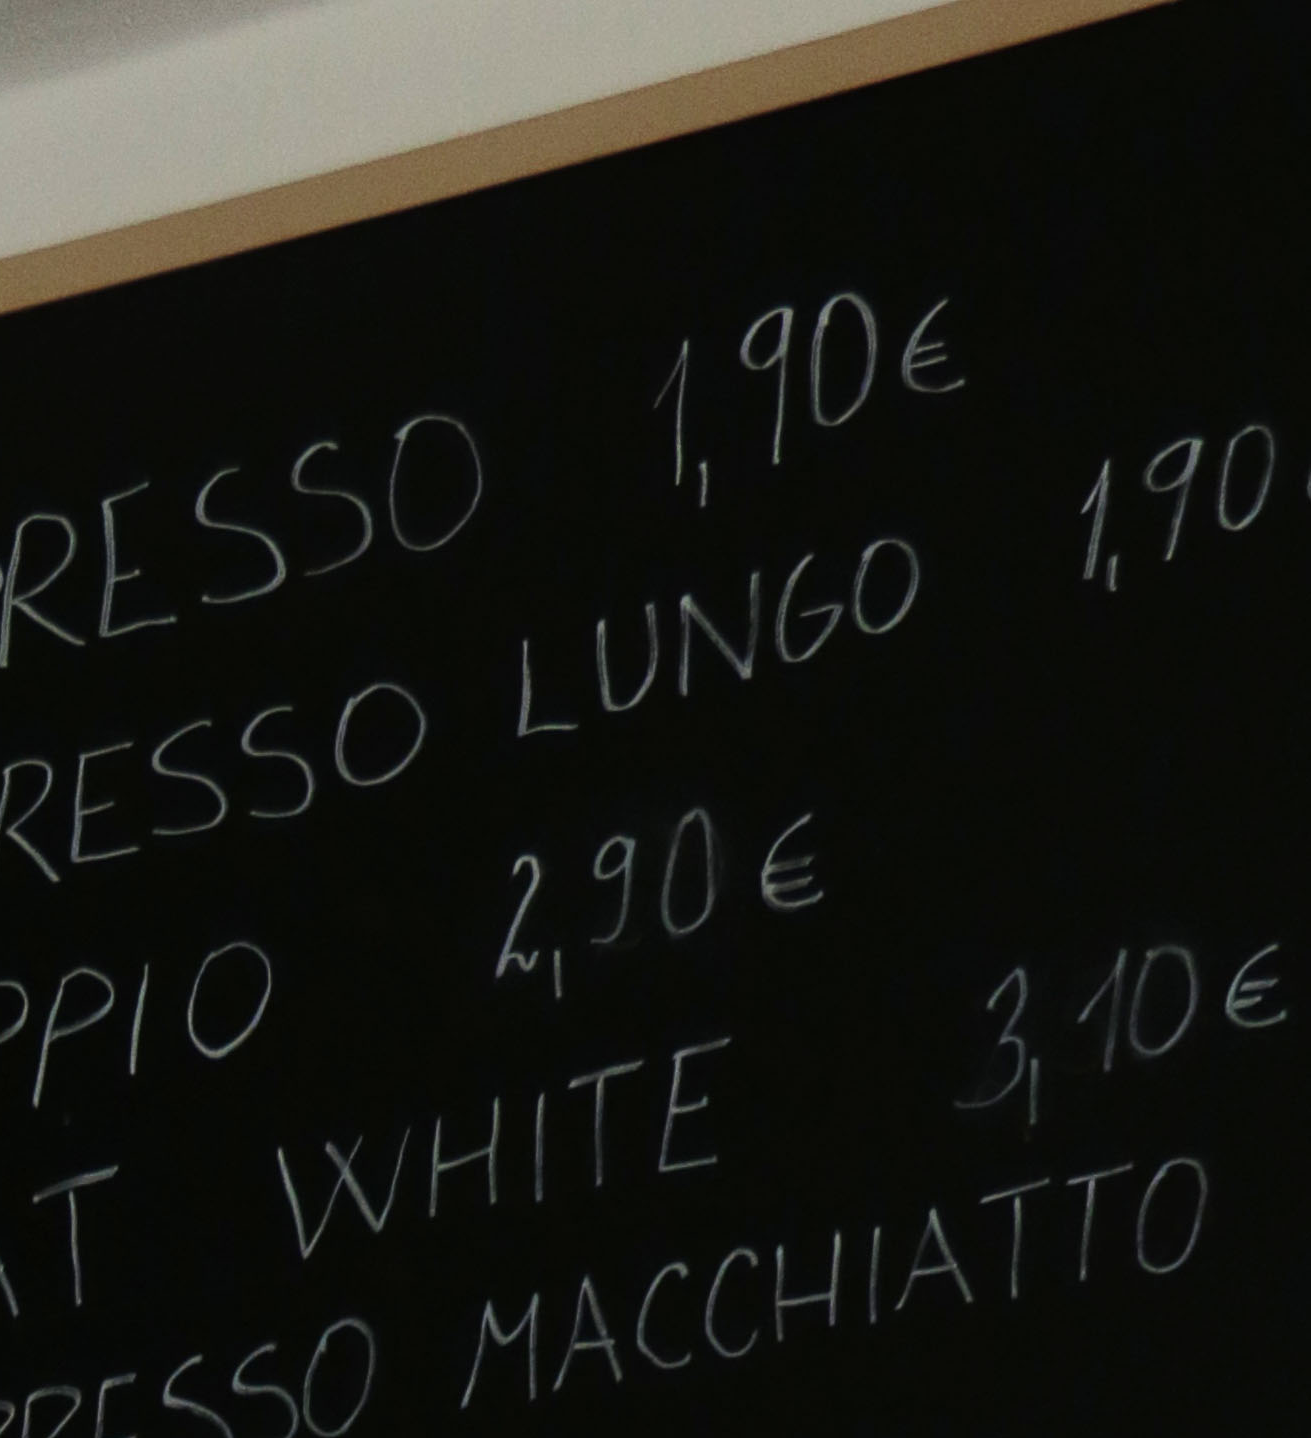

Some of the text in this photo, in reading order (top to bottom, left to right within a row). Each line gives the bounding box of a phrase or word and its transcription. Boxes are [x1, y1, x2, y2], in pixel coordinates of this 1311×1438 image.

[518, 538, 921, 736] LUNGO
[1080, 424, 1311, 592] 1,90
[277, 1037, 732, 1259] WHITE
[461, 1156, 1208, 1408] MACCHIATTO
